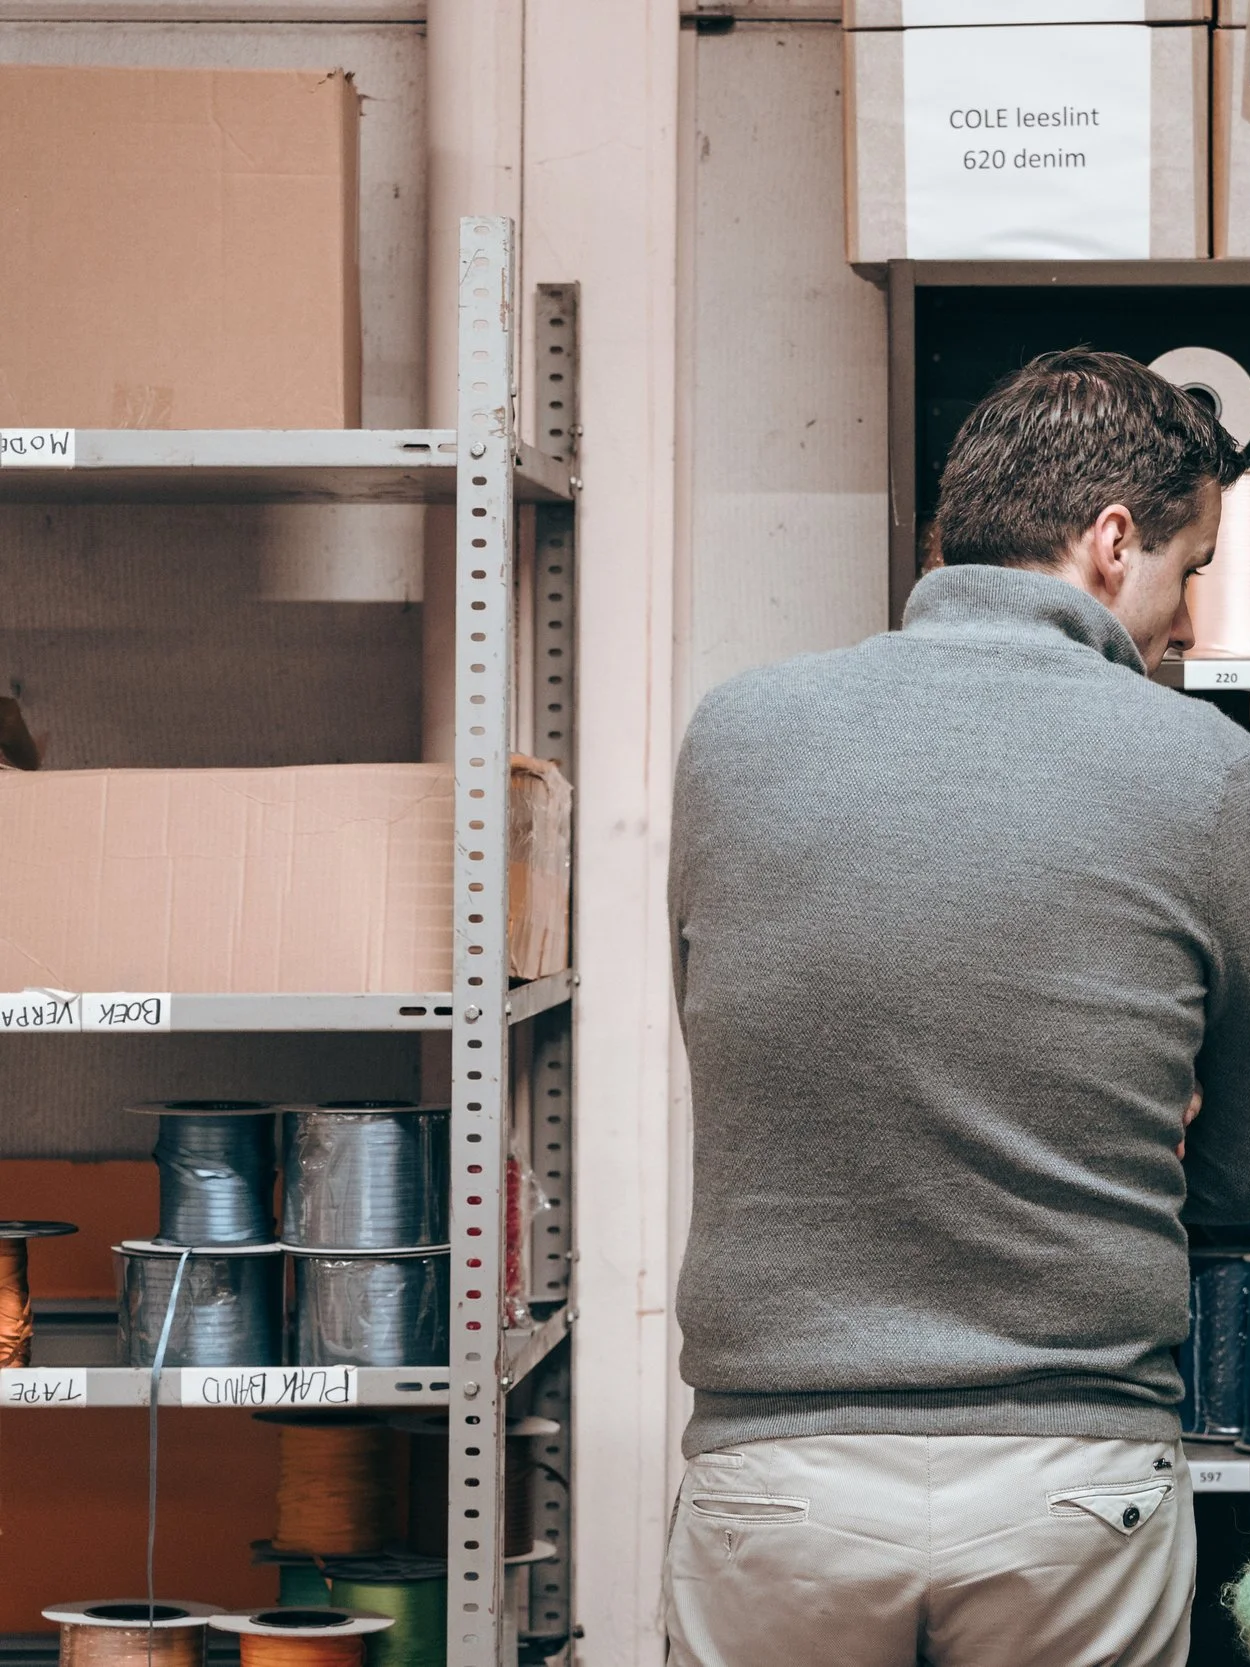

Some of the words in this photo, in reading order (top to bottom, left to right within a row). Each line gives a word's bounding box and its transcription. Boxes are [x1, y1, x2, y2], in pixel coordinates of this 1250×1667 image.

[949, 108, 1008, 129] COLE
[1017, 107, 1099, 128] leeslint
[963, 149, 1006, 170] 620
[1013, 148, 1086, 169] denim
[1215, 673, 1238, 683] 220
[1, 1001, 73, 1027] VERPA
[99, 998, 161, 1025] BOEK
[10, 1378, 82, 1402] TAPE
[202, 1372, 267, 1405] BAND
[1199, 1472, 1222, 1483] 597
